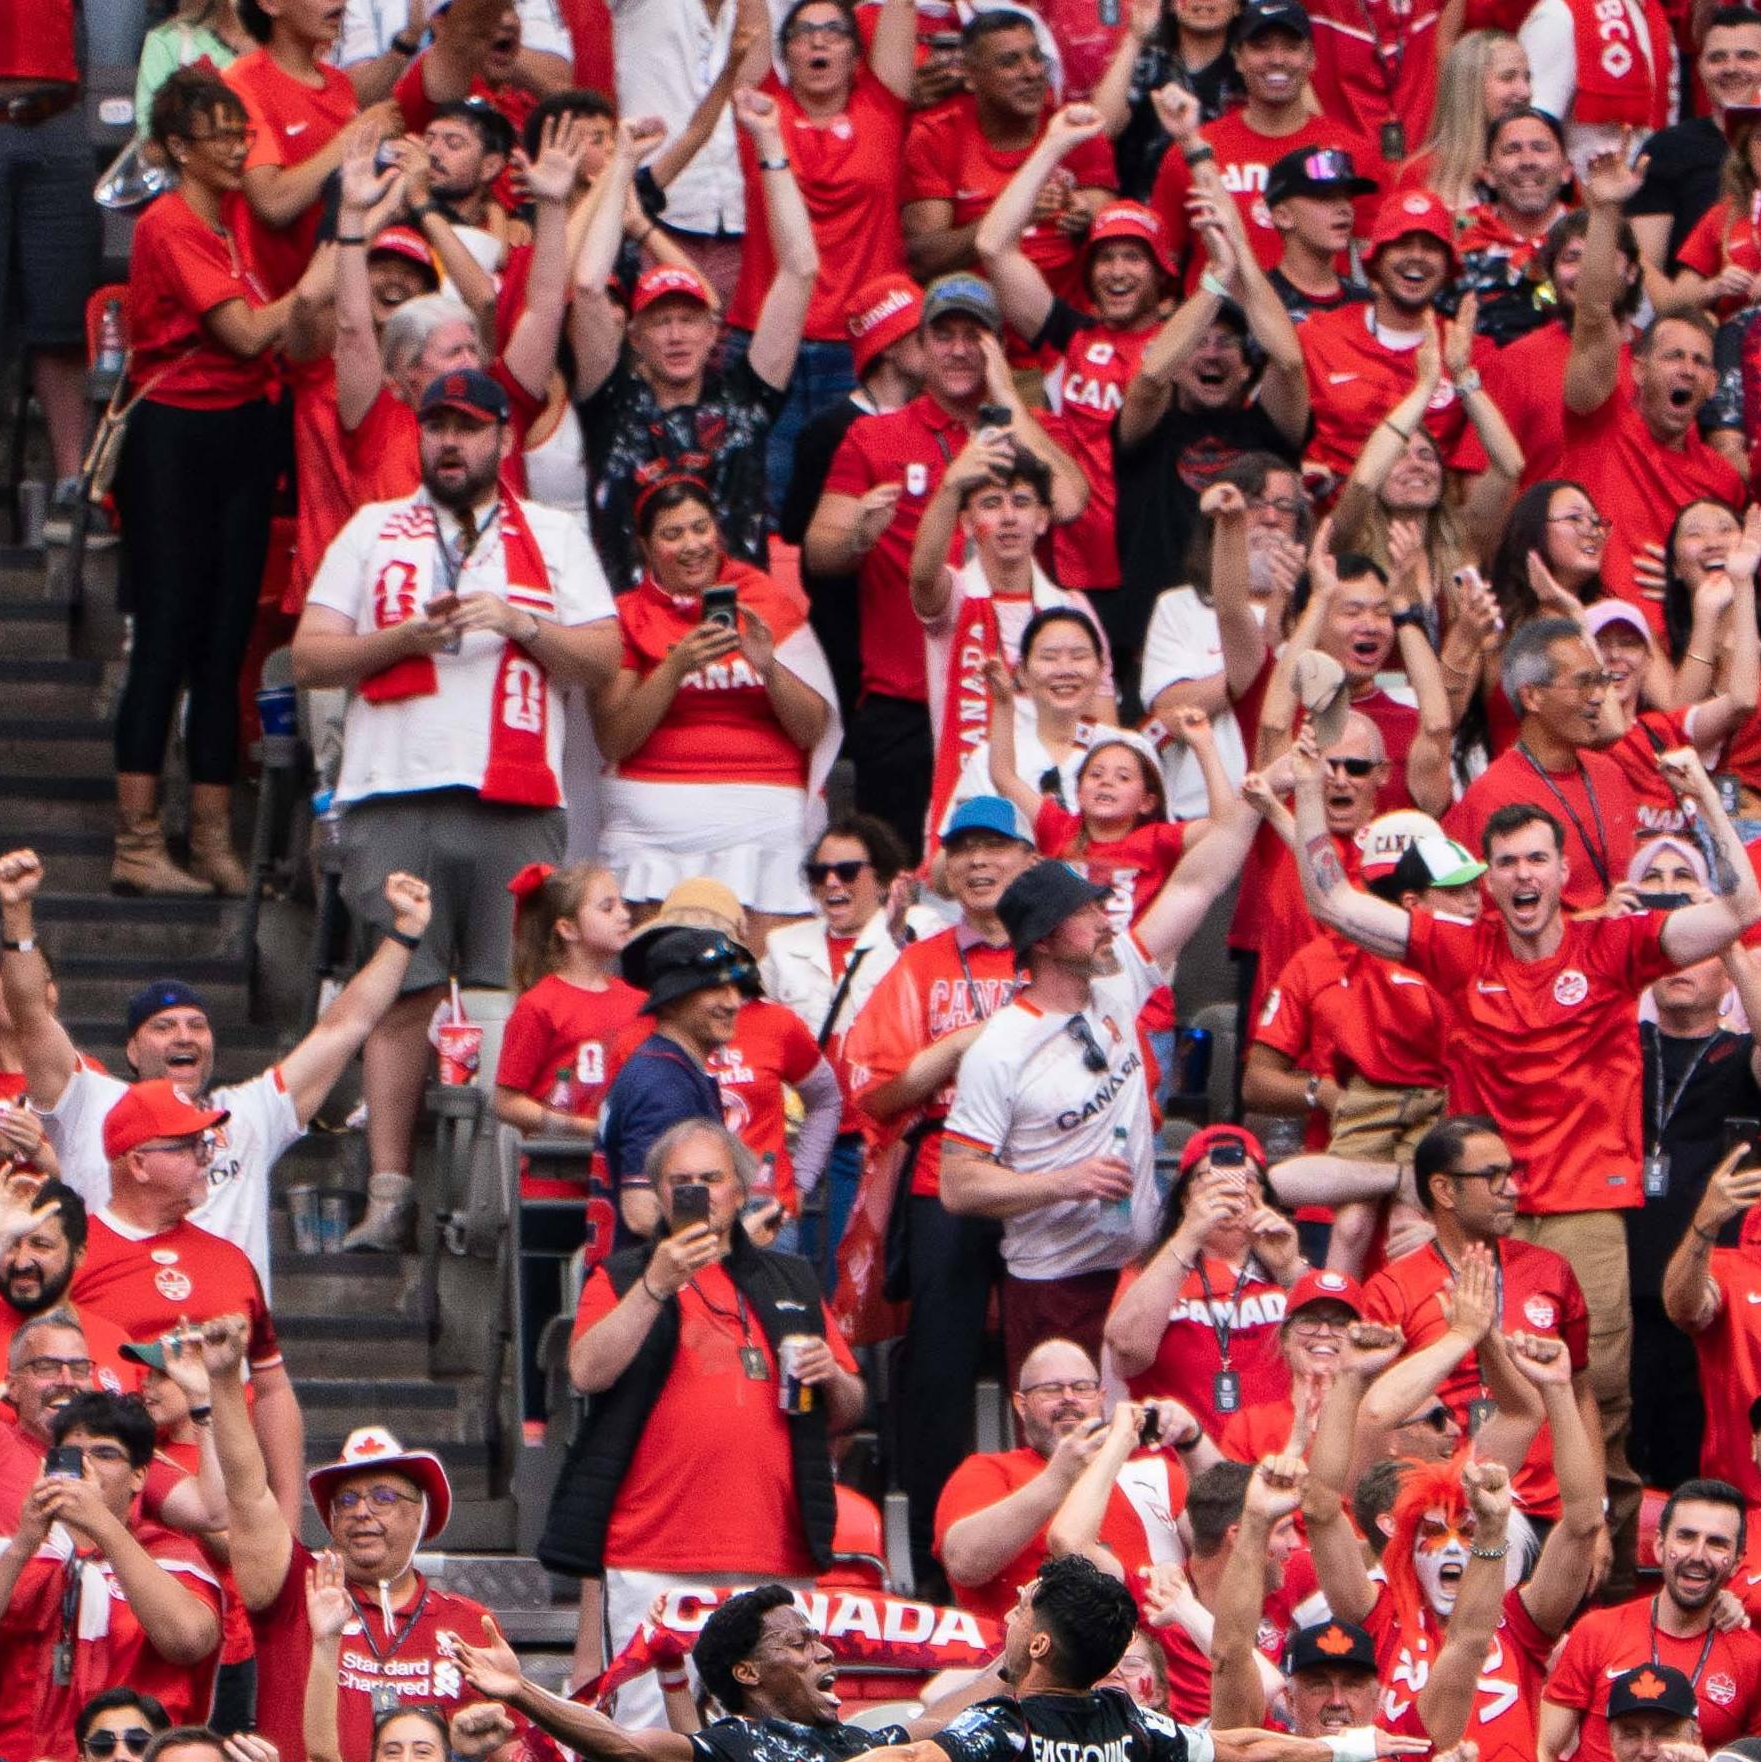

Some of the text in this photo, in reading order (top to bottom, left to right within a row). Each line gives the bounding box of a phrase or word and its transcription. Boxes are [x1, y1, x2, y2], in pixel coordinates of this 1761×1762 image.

[1165, 1293, 1285, 1328] CANAD
[664, 1586, 987, 1650] CNADA
[340, 1668, 429, 1697] Charered
